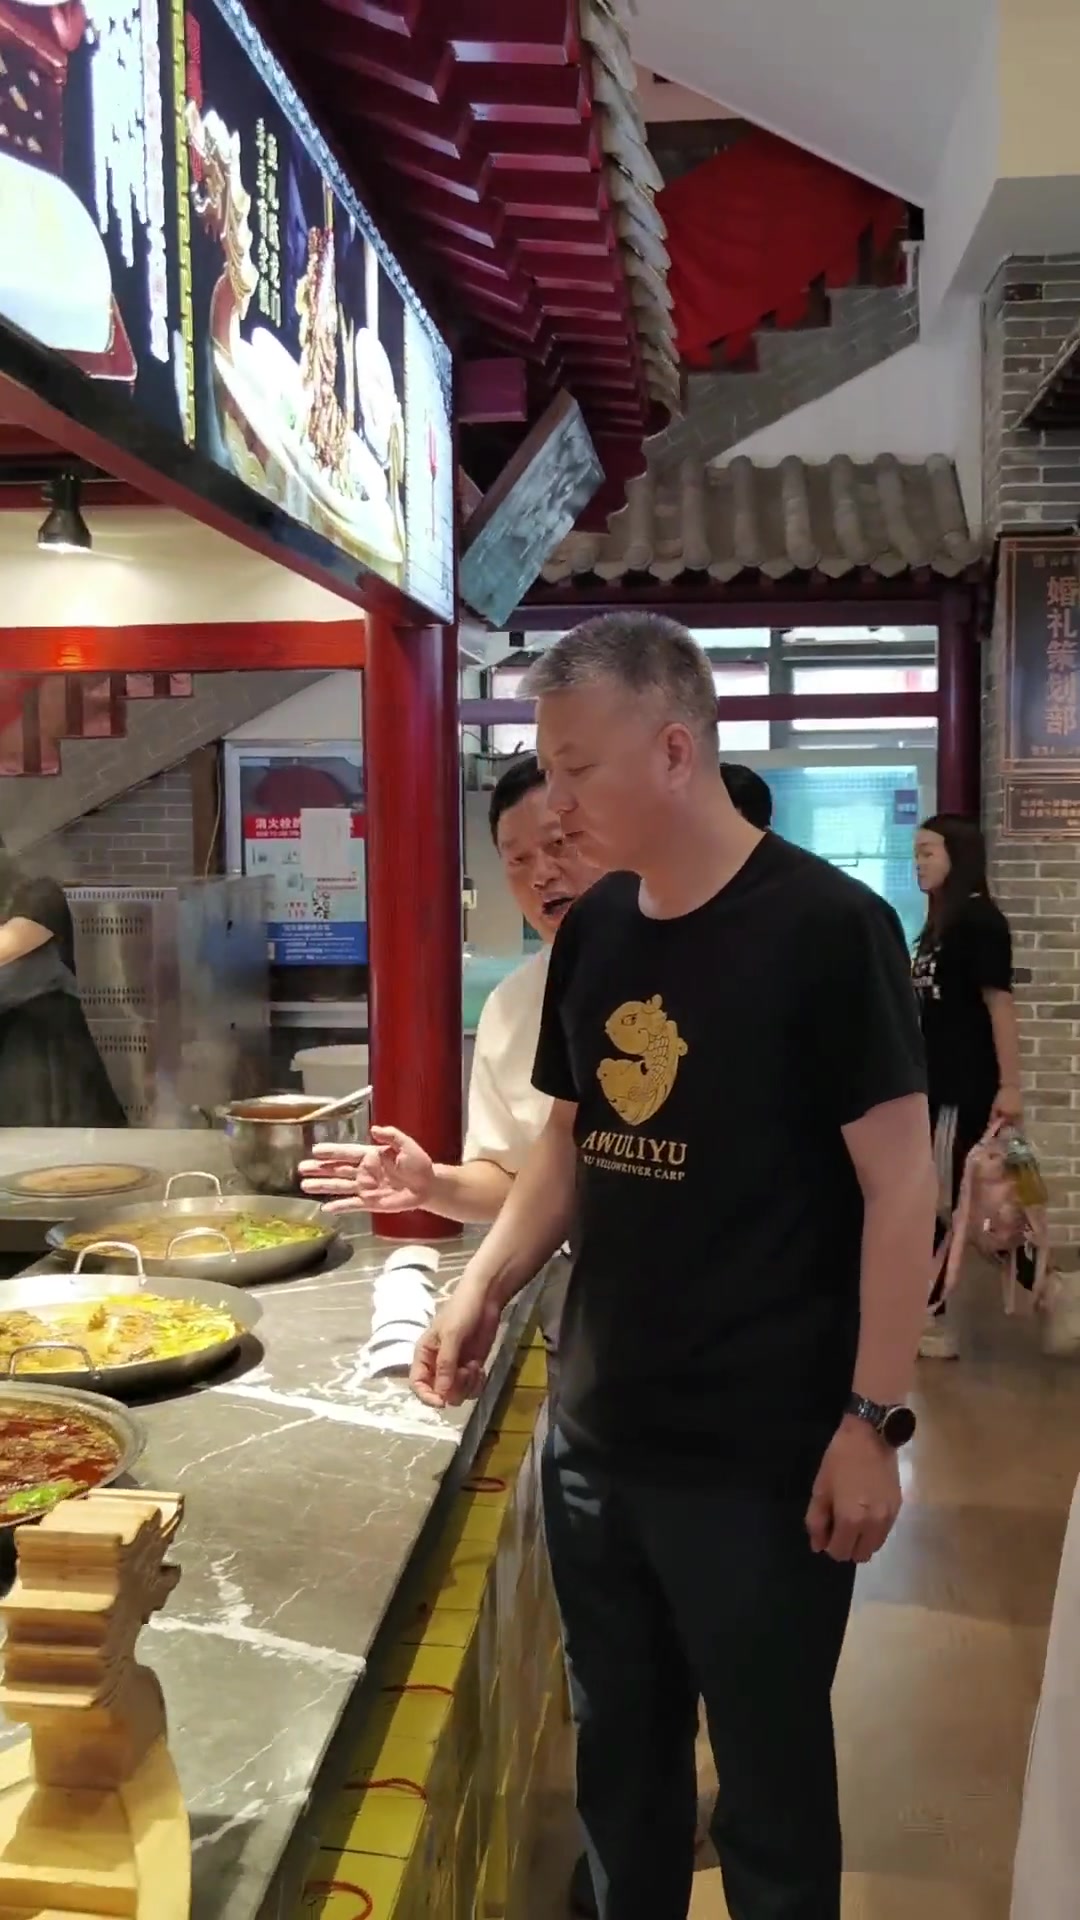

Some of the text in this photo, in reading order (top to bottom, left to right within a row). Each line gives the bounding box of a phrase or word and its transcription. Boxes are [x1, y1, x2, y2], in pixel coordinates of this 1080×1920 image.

[1045, 575, 1078, 737] 婚礼策划部
[581, 1130, 688, 1166] AWULIYU
[654, 1168, 686, 1181] CARP
